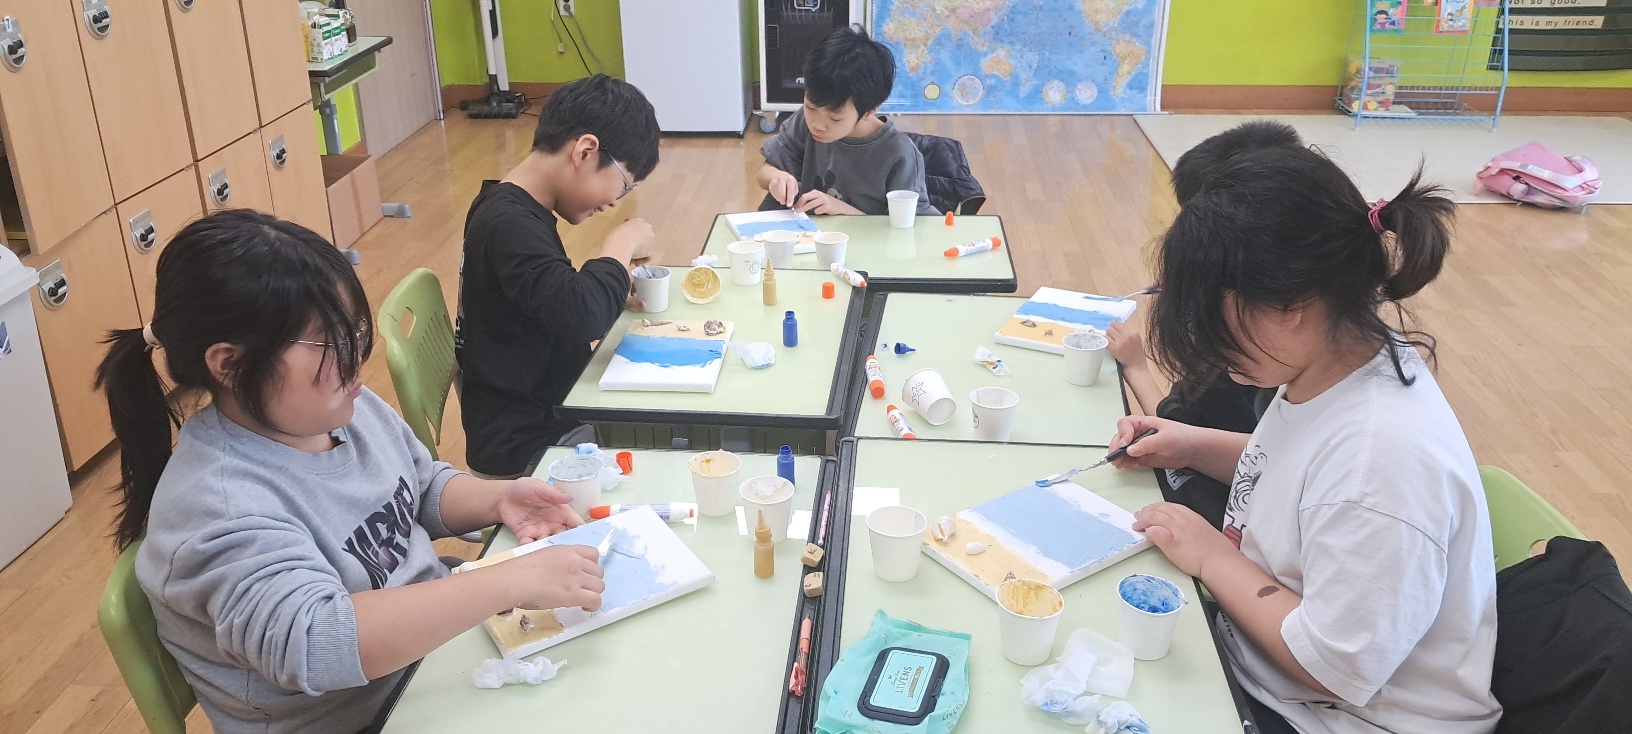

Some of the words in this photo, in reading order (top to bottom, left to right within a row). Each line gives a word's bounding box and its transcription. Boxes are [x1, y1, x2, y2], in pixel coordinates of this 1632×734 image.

[1530, 19, 1540, 27] is
[1545, 20, 1559, 28] my
[1563, 19, 1598, 27] friend.
[895, 666, 912, 693] LIVENS
